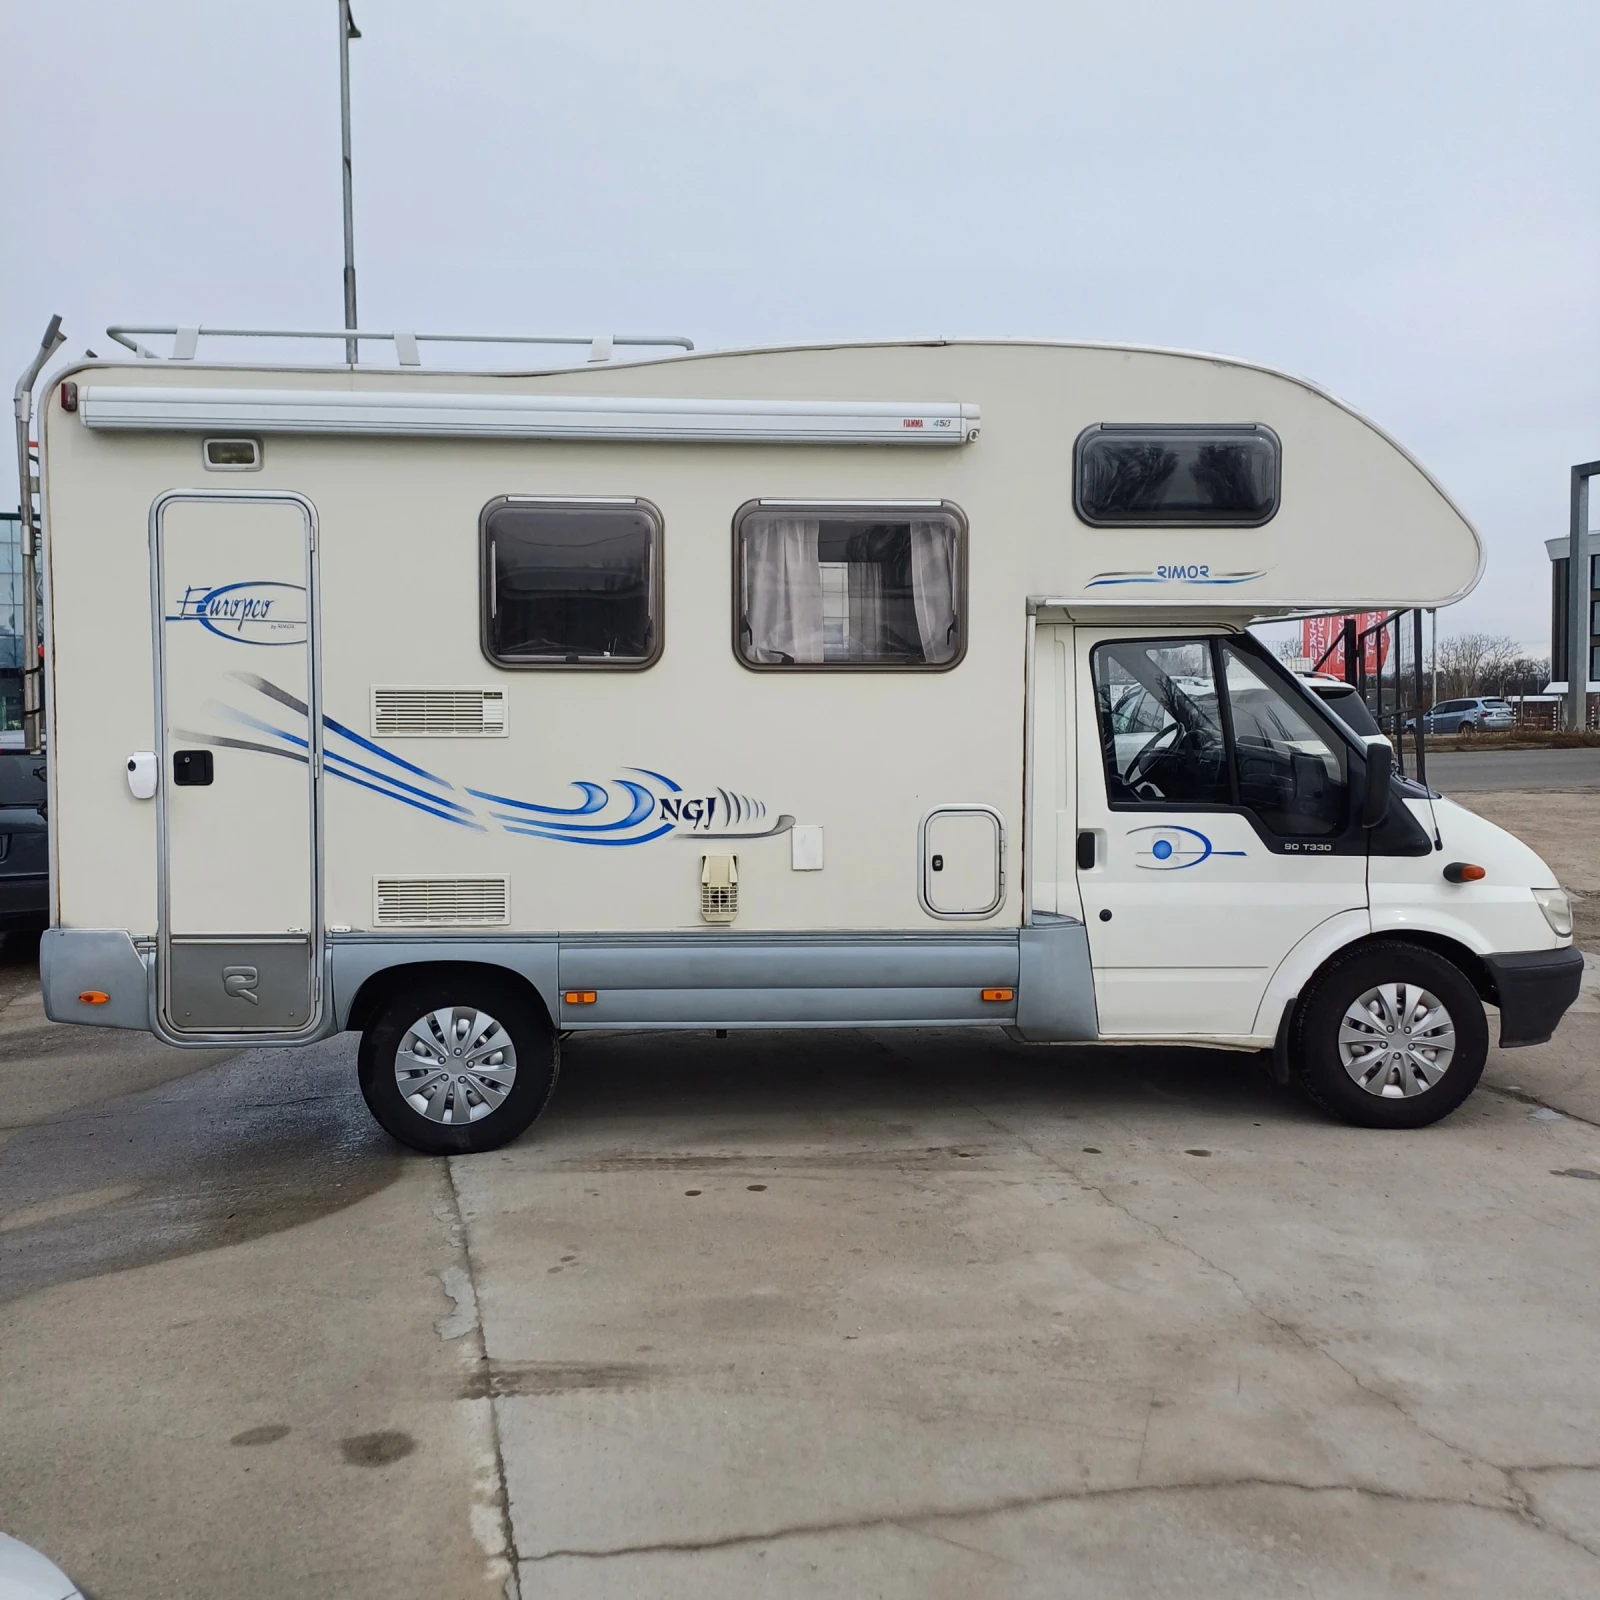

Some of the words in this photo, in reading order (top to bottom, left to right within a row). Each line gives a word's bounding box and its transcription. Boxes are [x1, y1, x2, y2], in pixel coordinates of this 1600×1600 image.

[1157, 565, 1209, 579] RIMOR
[1284, 843, 1300, 851] 90
[1302, 843, 1332, 851] T330
